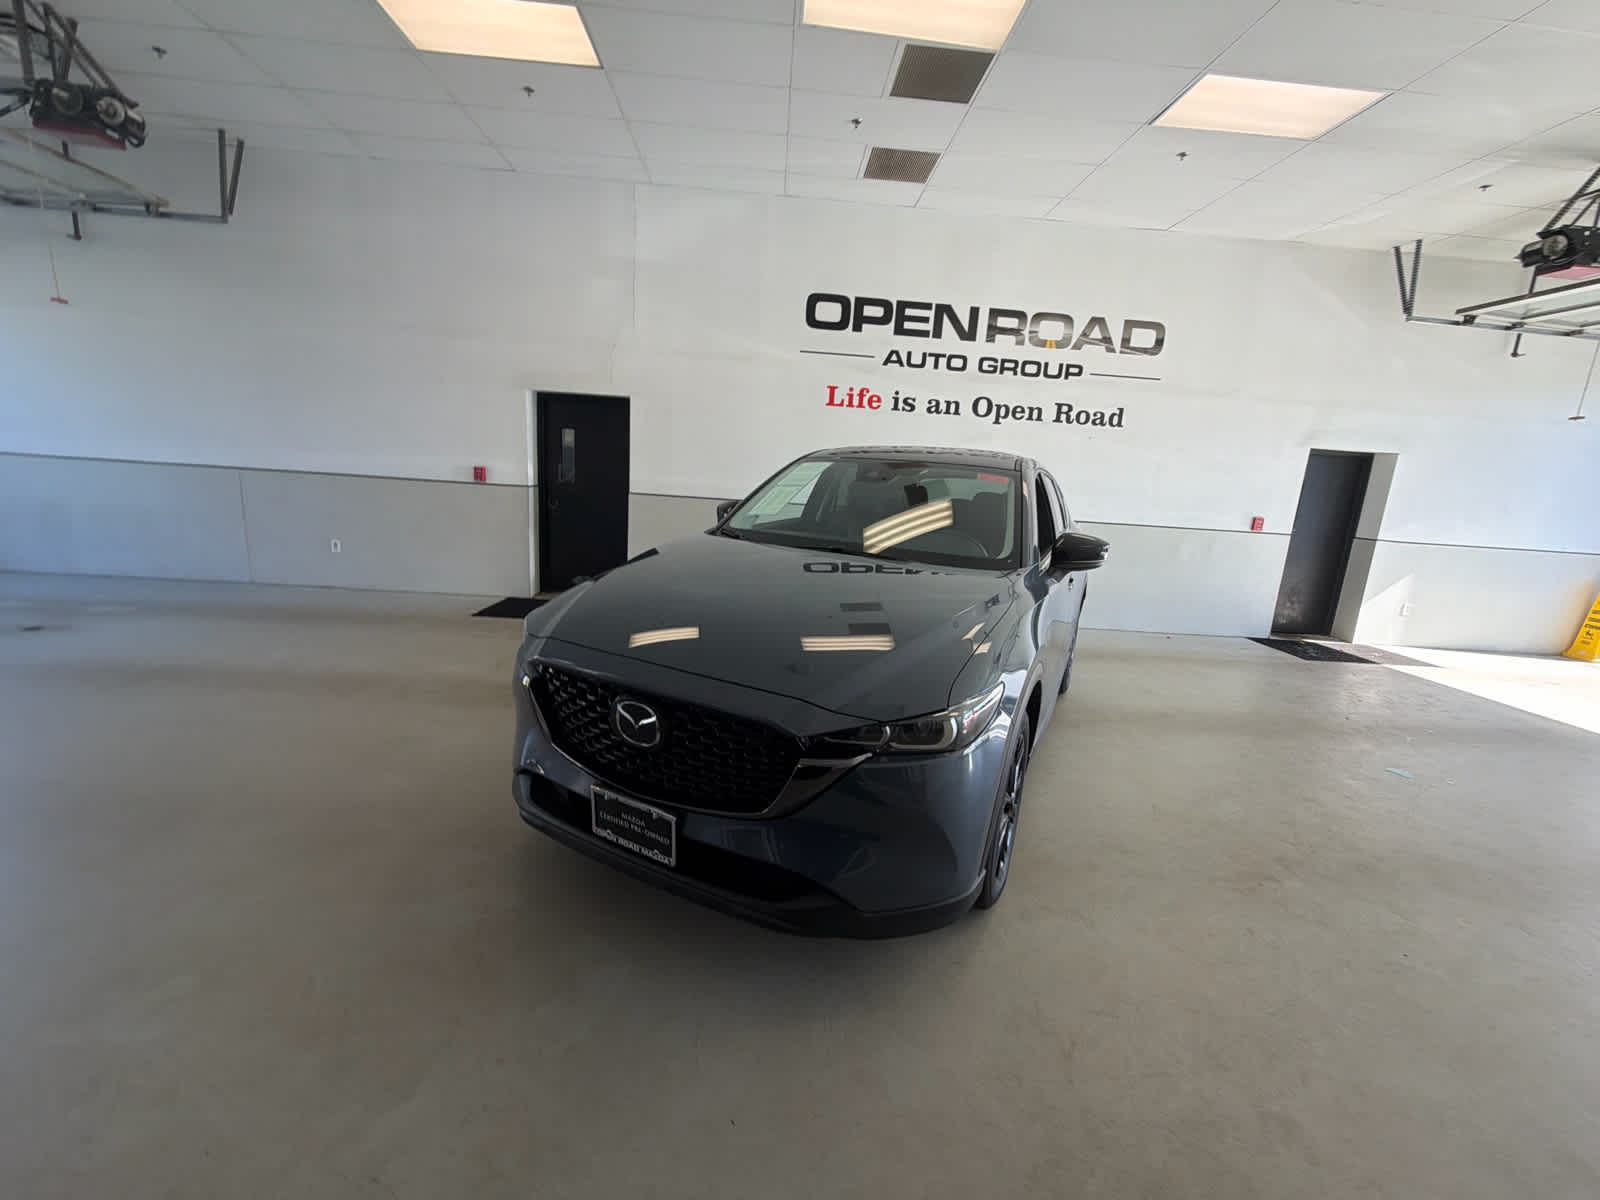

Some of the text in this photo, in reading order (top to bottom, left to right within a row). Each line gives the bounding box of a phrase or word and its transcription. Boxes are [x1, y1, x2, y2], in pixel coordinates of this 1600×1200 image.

[882, 349, 1084, 381] AUTO GROUP
[825, 385, 1125, 428] Life is an Open Road
